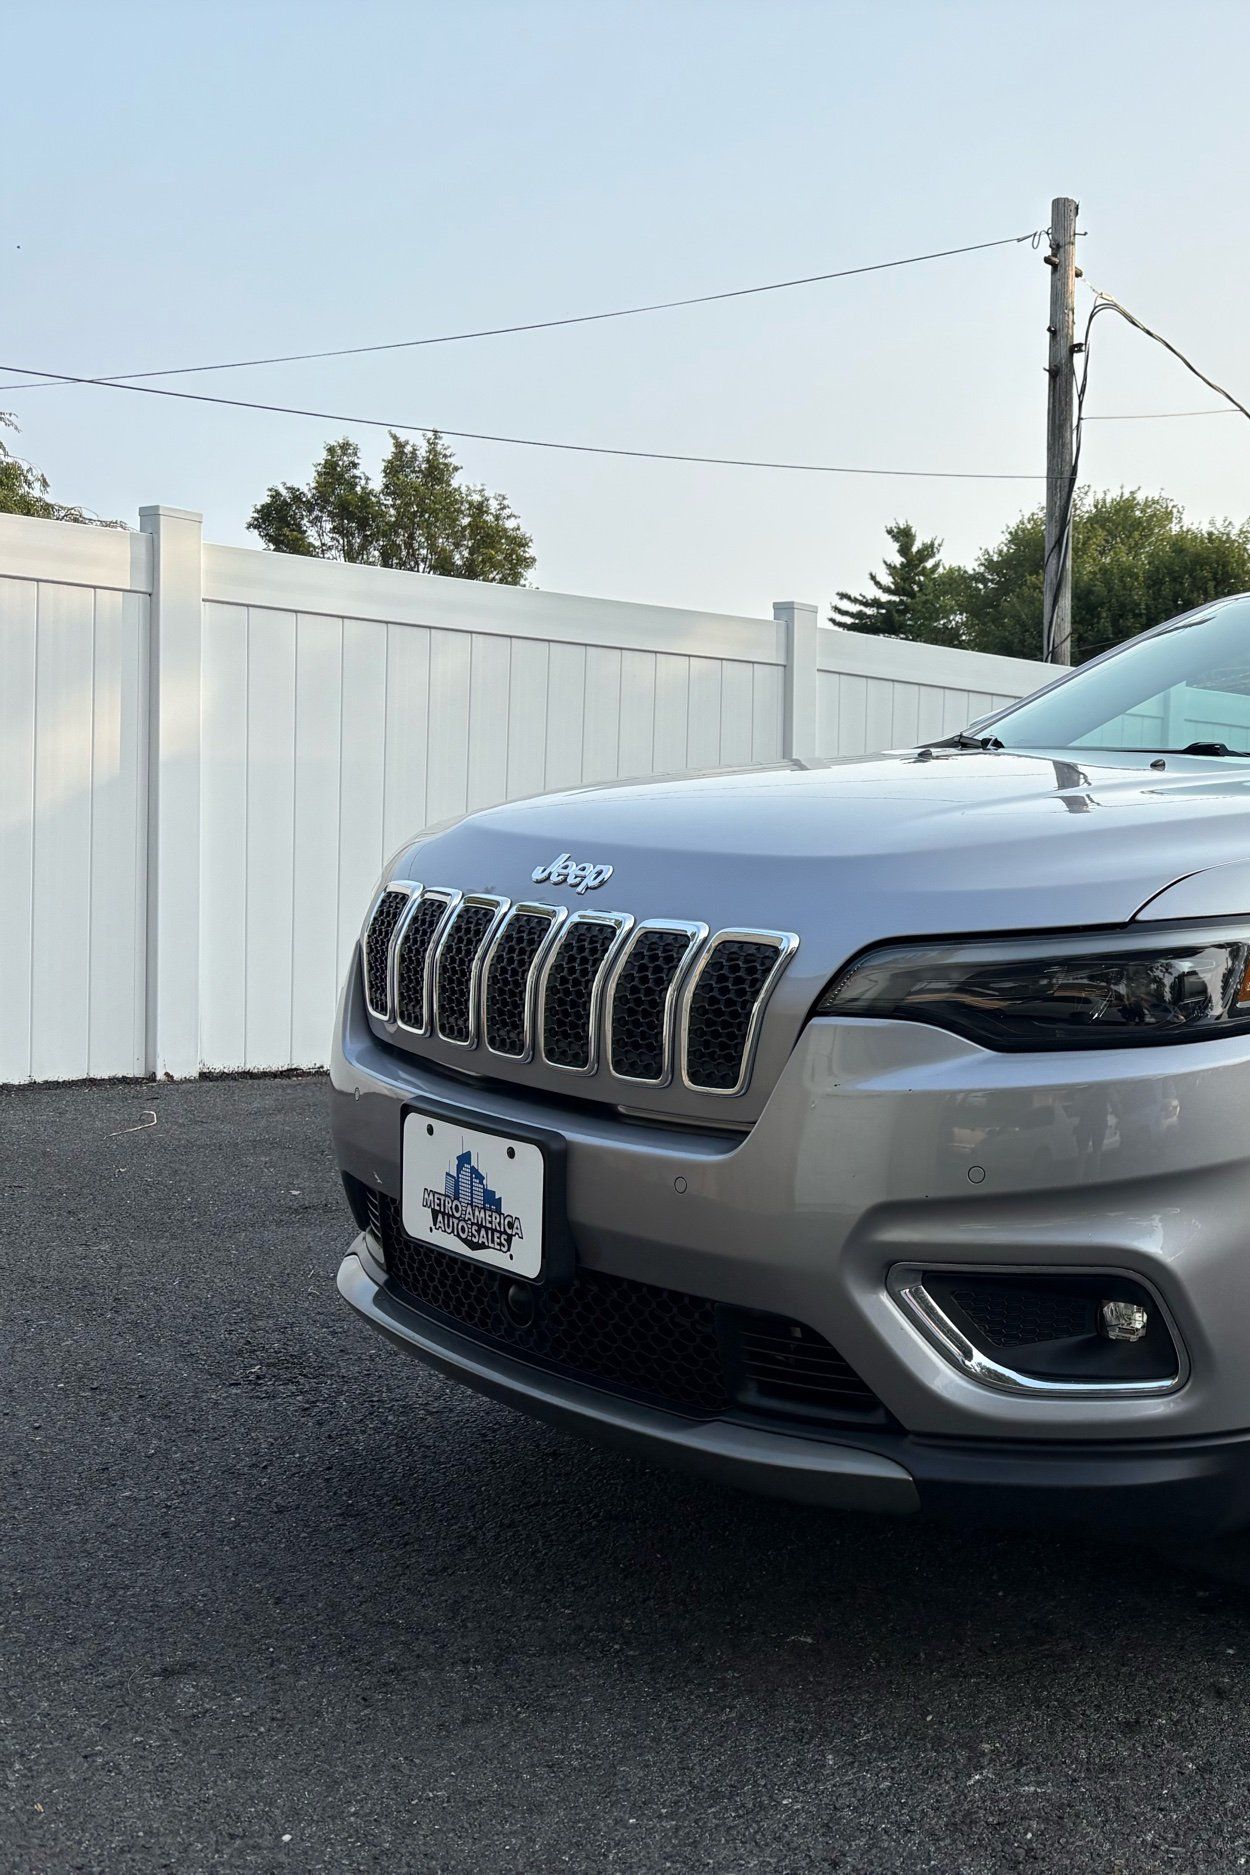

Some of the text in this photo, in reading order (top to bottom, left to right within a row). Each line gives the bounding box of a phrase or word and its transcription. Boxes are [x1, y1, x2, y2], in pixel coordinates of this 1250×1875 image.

[531, 853, 614, 895] Jeep
[422, 1188, 523, 1240] METRO AMERICA
[434, 1212, 510, 1253] AUTO SALES
